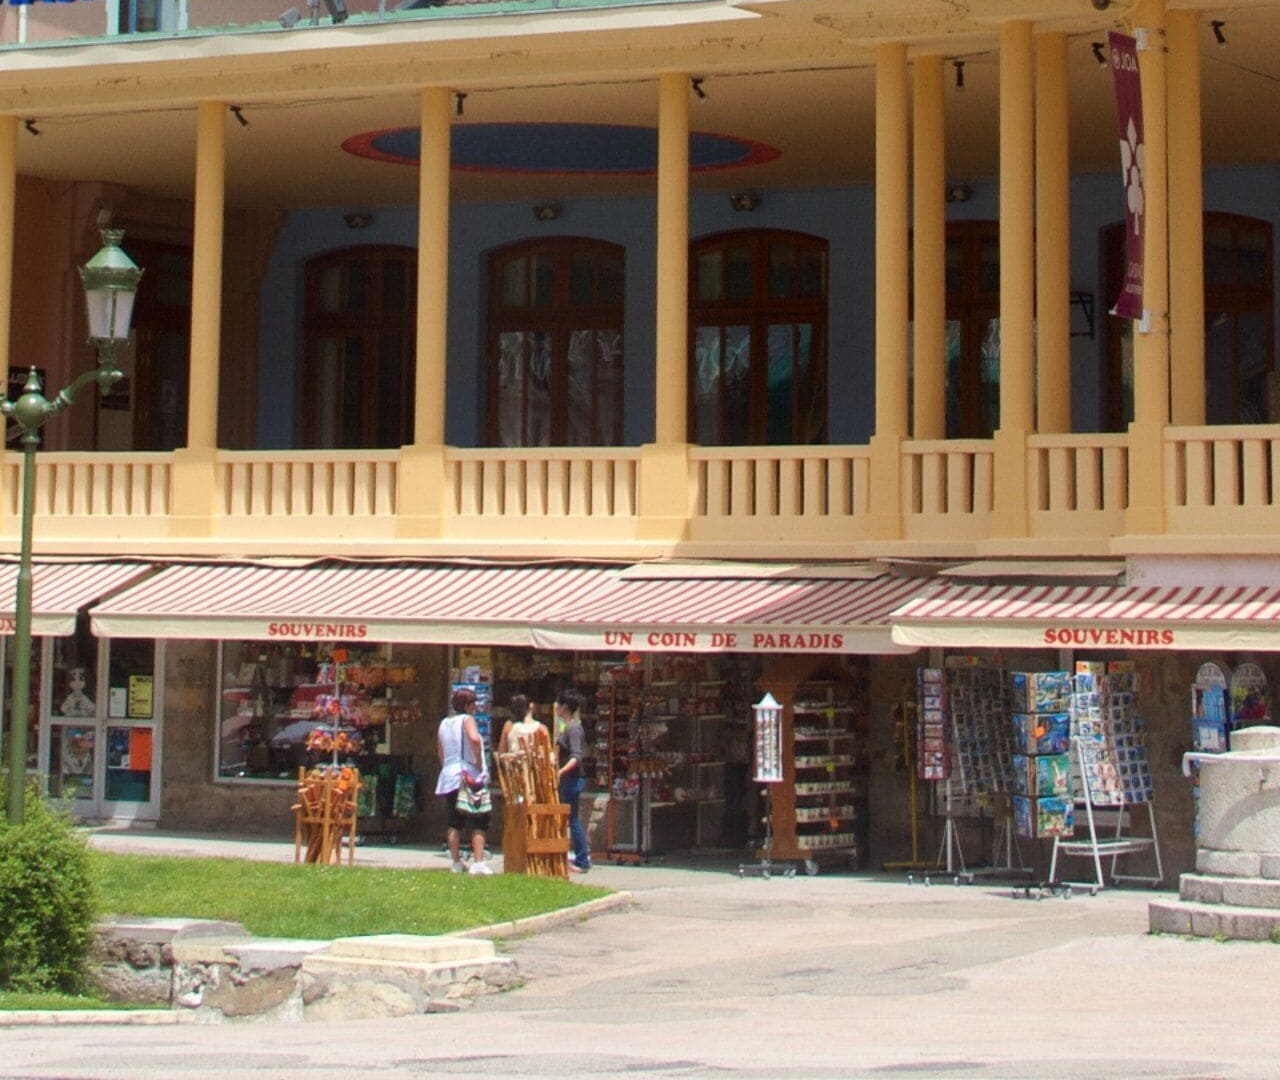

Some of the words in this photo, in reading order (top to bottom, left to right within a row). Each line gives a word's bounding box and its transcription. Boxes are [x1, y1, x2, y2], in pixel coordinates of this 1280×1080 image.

[268, 623, 367, 638] SOUVENIRS
[1044, 628, 1174, 645] SOUVENIRS
[604, 631, 633, 645] UN
[647, 632, 696, 647] COIN
[711, 633, 737, 647] DE
[753, 633, 843, 649] PARADIS
